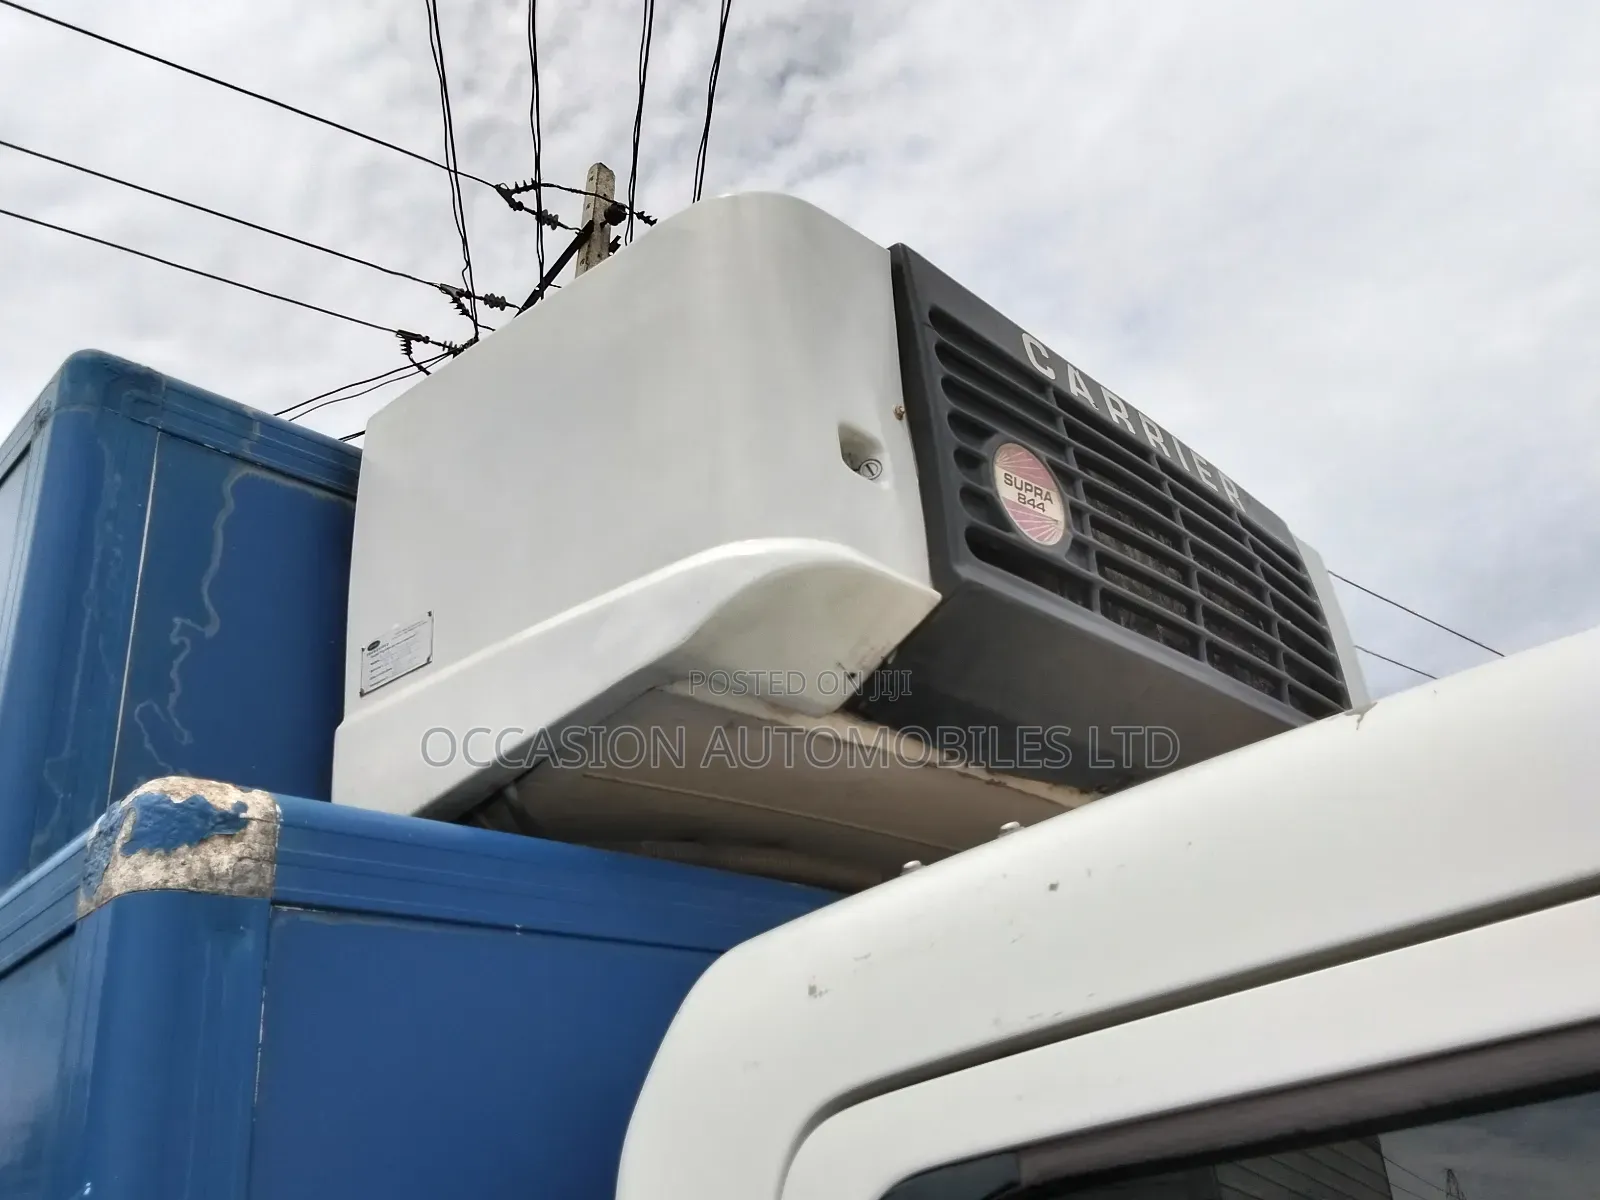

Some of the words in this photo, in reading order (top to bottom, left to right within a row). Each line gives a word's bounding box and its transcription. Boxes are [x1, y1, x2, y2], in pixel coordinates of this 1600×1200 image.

[1022, 333, 1246, 513] CARRIER
[1004, 473, 1054, 505] SUPRA
[1017, 492, 1046, 513] 844
